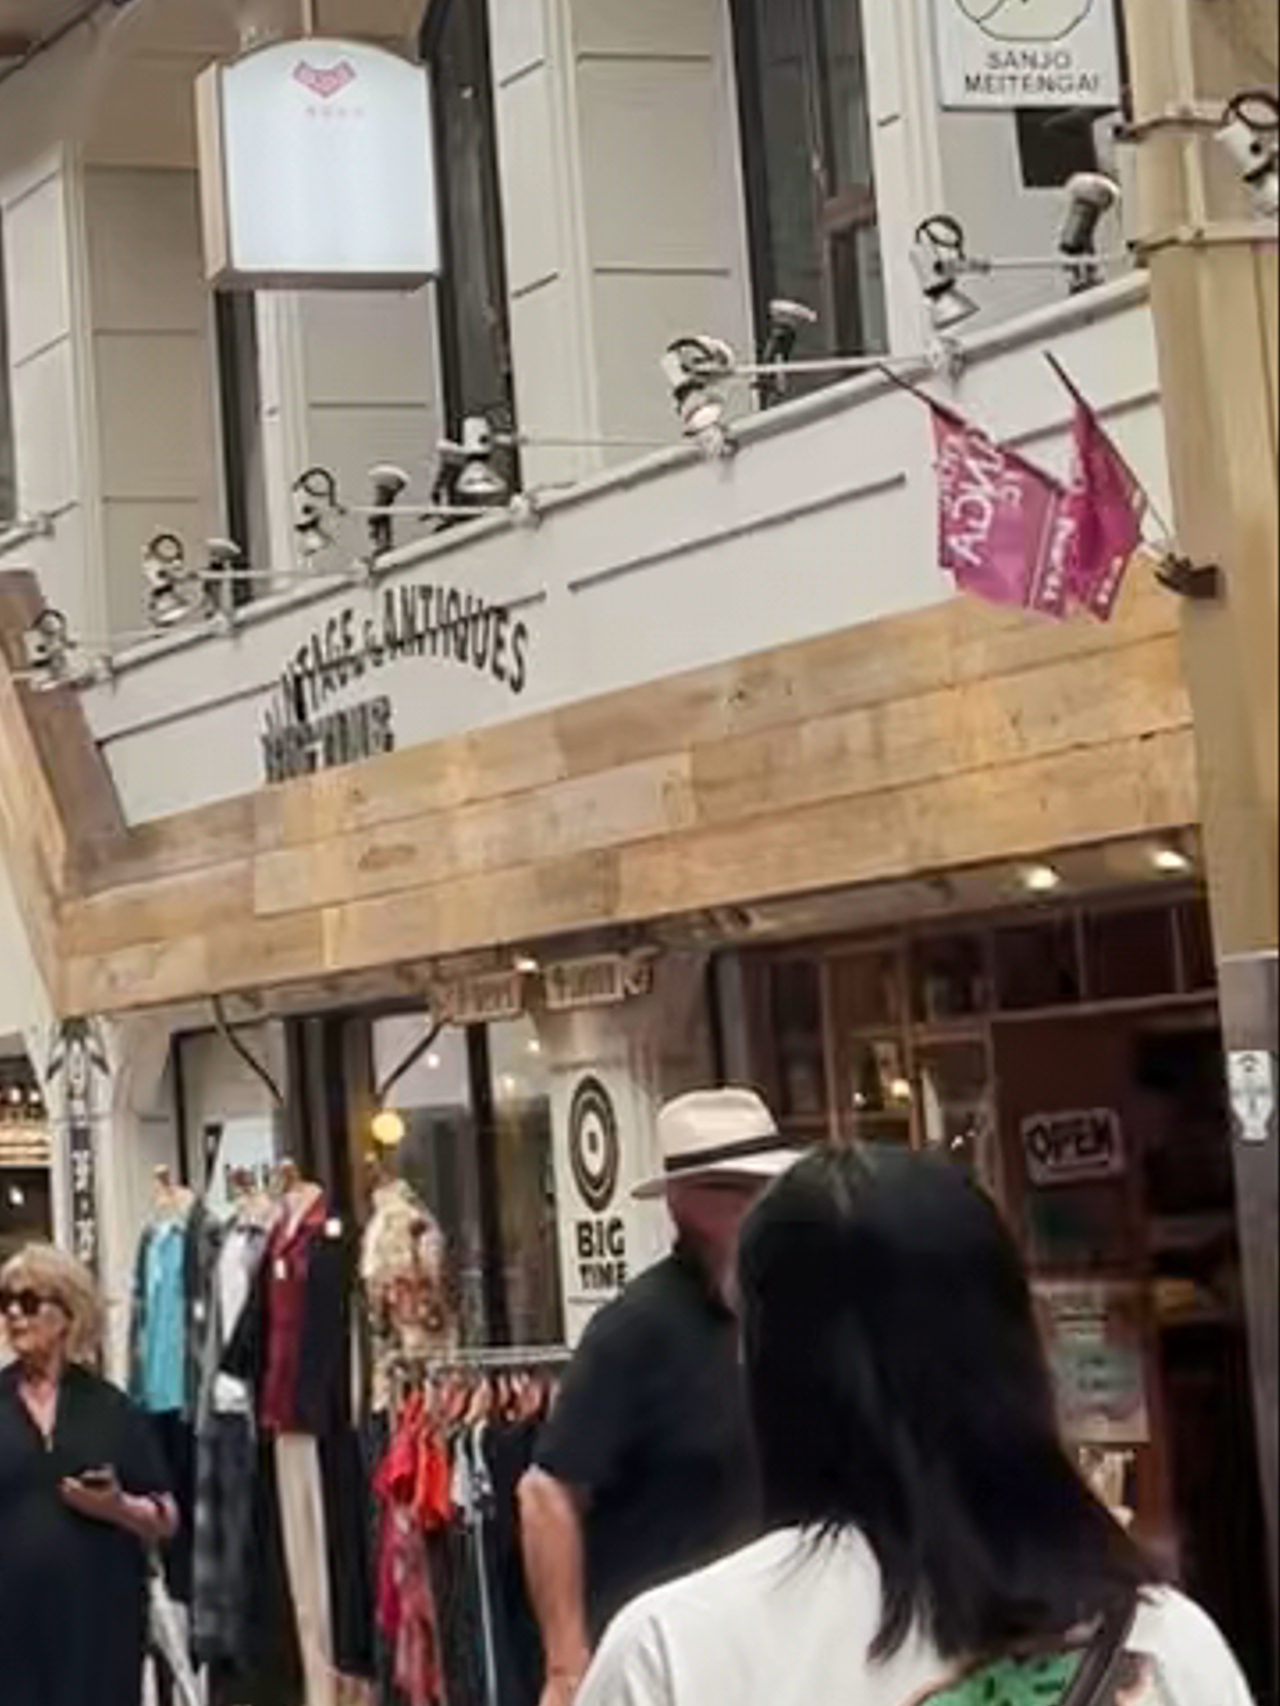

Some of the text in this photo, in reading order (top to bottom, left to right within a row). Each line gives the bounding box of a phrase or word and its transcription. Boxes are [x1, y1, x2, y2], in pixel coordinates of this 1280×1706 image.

[985, 50, 1073, 71] SANJO
[963, 73, 1100, 95] MEITENGAI
[383, 584, 529, 694] ANTIQUES
[575, 1217, 626, 1260] BIG
[578, 1260, 627, 1291] TIME
